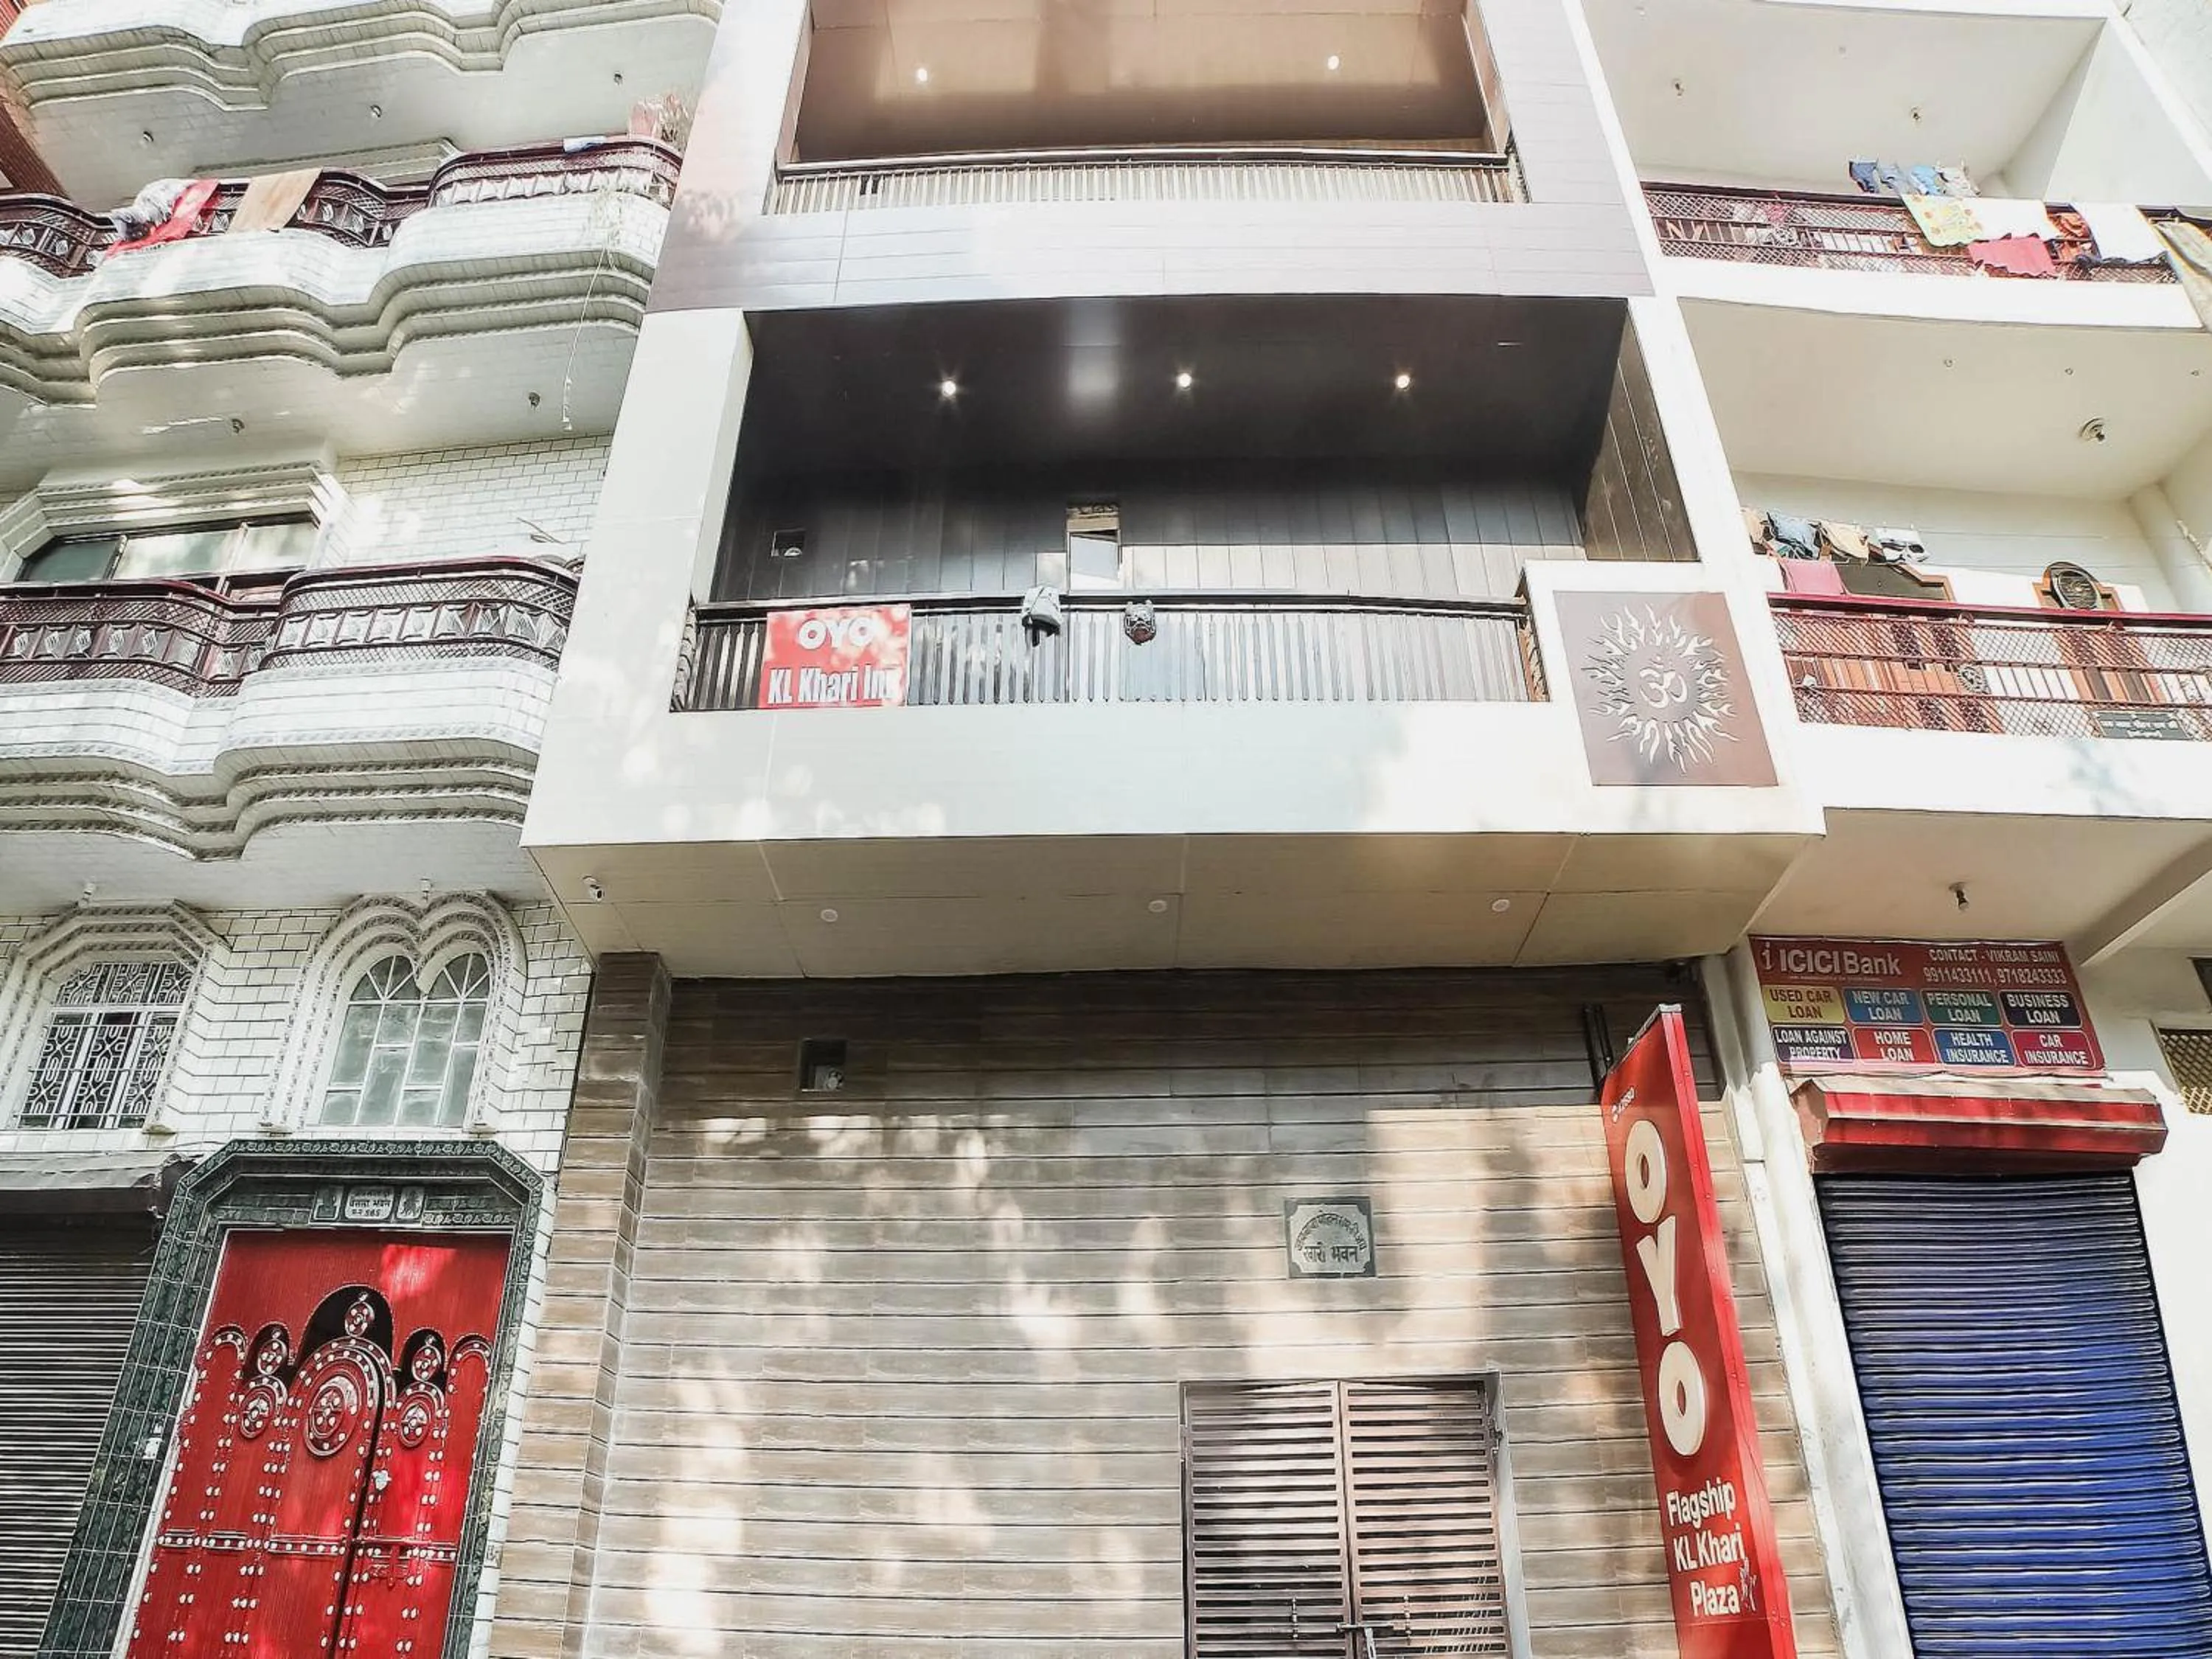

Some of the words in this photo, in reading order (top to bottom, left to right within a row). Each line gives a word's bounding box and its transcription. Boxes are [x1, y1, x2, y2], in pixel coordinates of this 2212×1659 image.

[799, 617, 874, 650] OYO
[768, 668, 793, 704] KL
[799, 664, 859, 703] Khari
[1778, 948, 1840, 974] ICICI
[1843, 950, 1902, 975] Bank
[1928, 949, 1978, 961] CONTACT
[1989, 949, 2028, 962] VIKRAM
[2030, 950, 2059, 962] SAINI
[1770, 989, 1803, 1002] USED
[1807, 990, 1833, 1004] CAR
[1852, 990, 1881, 1004] NEW
[1882, 992, 1910, 1005] CAR
[1926, 992, 1993, 1006] PERSONAL
[2006, 994, 2070, 1009] BUSINESS
[1788, 1005, 1823, 1018] LOAN
[1868, 1007, 1903, 1020] LOAN
[1947, 1009, 1982, 1023] LOAN
[2025, 1009, 2061, 1024] LOAN
[1775, 1029, 1804, 1044] LOAN
[1806, 1030, 1848, 1043] AGAINST
[1874, 1032, 1912, 1045] HOME
[1952, 1033, 1994, 1046] HEALTH
[2039, 1034, 2064, 1048] CAR
[1790, 1046, 1841, 1060] PROPERTY
[1881, 1048, 1915, 1062] LOAN
[1947, 1048, 2009, 1063] INSURANCE
[2025, 1051, 2089, 1065] INSURANCE
[1330, 1245, 1358, 1262] भवन
[1624, 1119, 1705, 1456] OYO
[1666, 1476, 1736, 1528] Flagship
[1673, 1535, 1698, 1572] KL
[1697, 1522, 1746, 1568] Khari
[1690, 1580, 1741, 1617] Plaza
